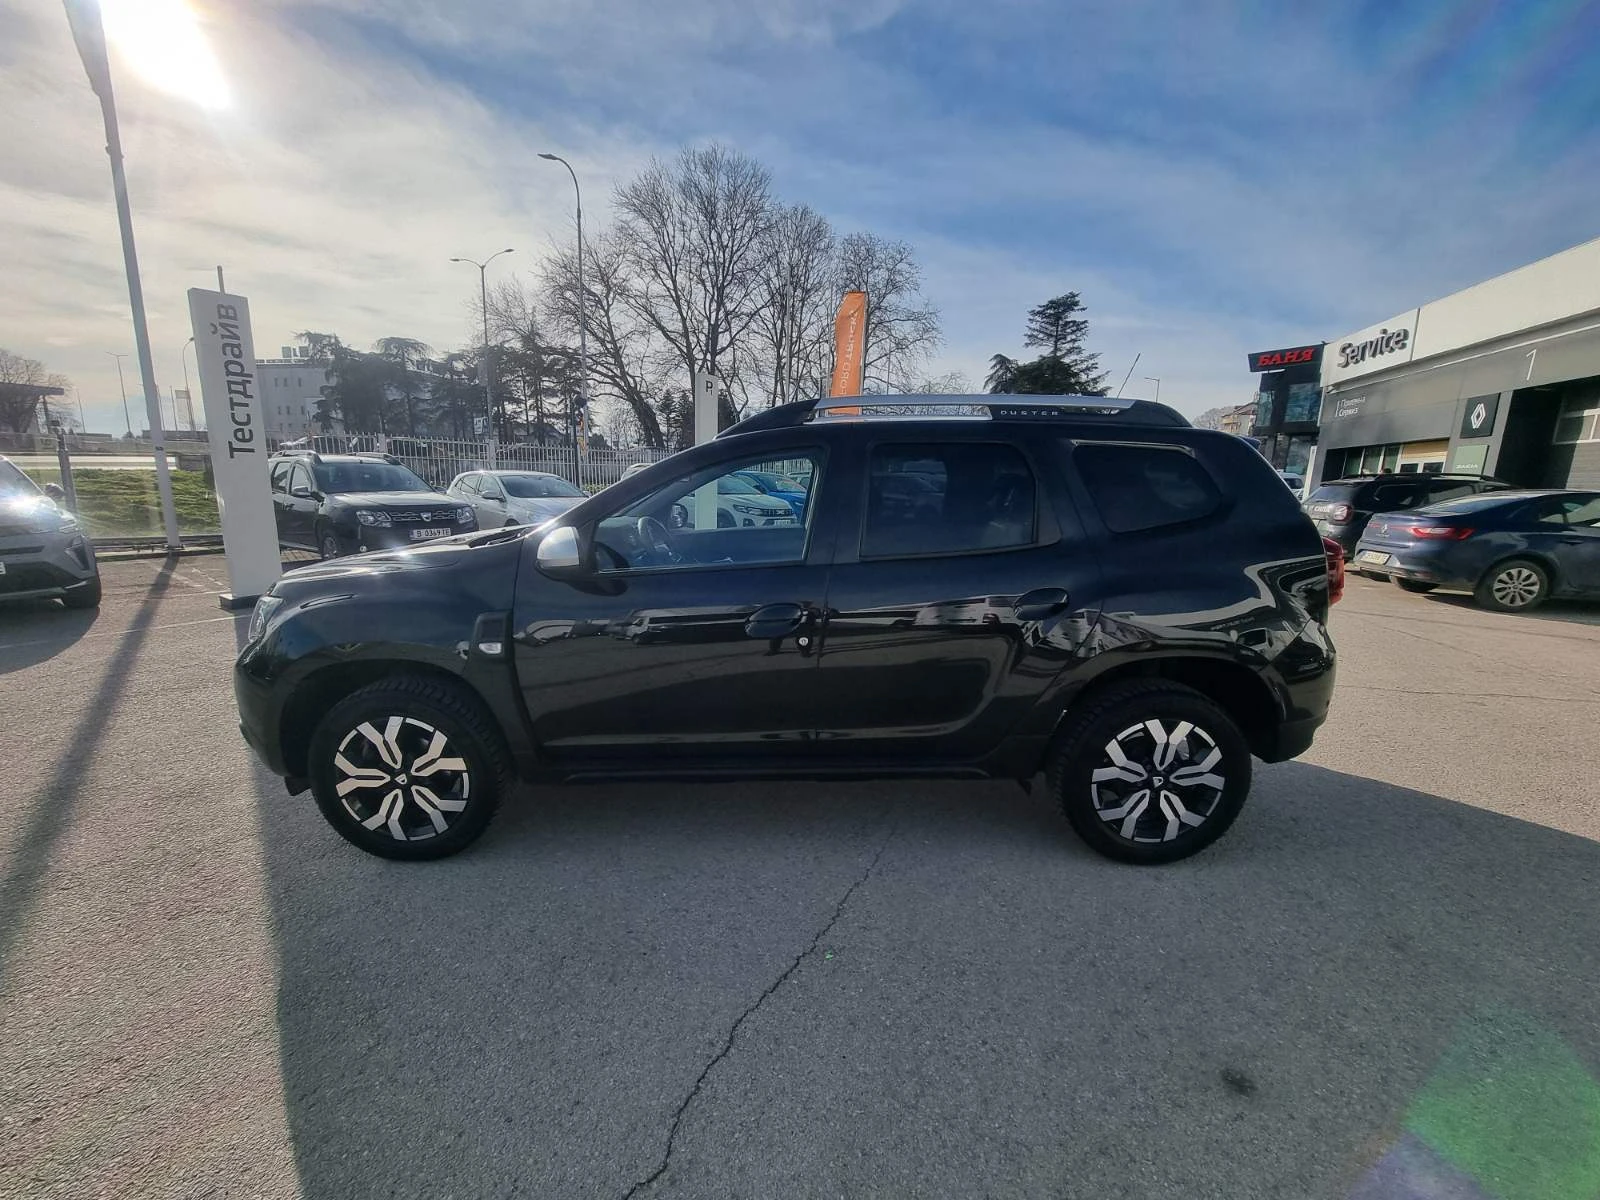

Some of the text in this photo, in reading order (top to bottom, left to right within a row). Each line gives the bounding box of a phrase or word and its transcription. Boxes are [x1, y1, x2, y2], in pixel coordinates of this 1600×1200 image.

[1258, 347, 1314, 367] БАНЯ
[1337, 327, 1410, 368] Service
[1525, 348, 1538, 381] 1
[211, 303, 255, 459] Тестдрайв
